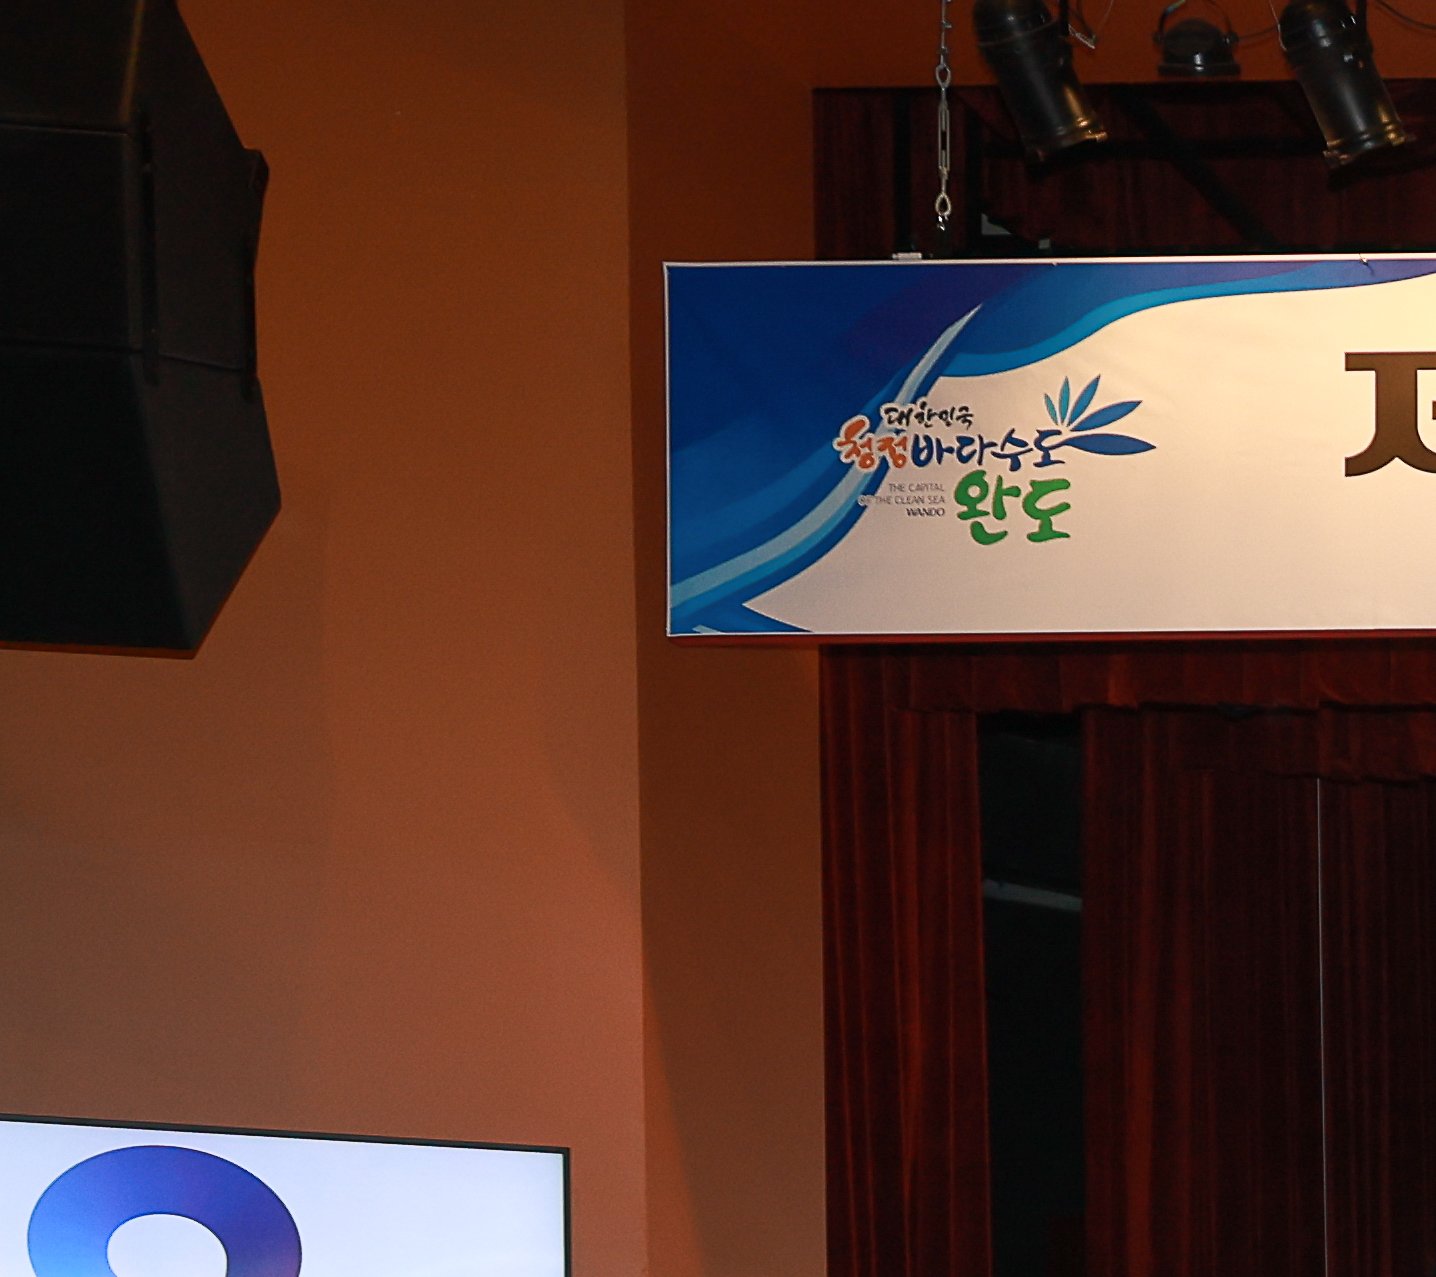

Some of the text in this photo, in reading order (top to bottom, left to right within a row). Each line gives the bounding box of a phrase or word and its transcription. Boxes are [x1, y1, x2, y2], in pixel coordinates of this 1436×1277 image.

[894, 495, 926, 505] CLEAN
[928, 495, 946, 505] SEA
[906, 507, 946, 518] WANDO
[954, 469, 1071, 545] 완도
